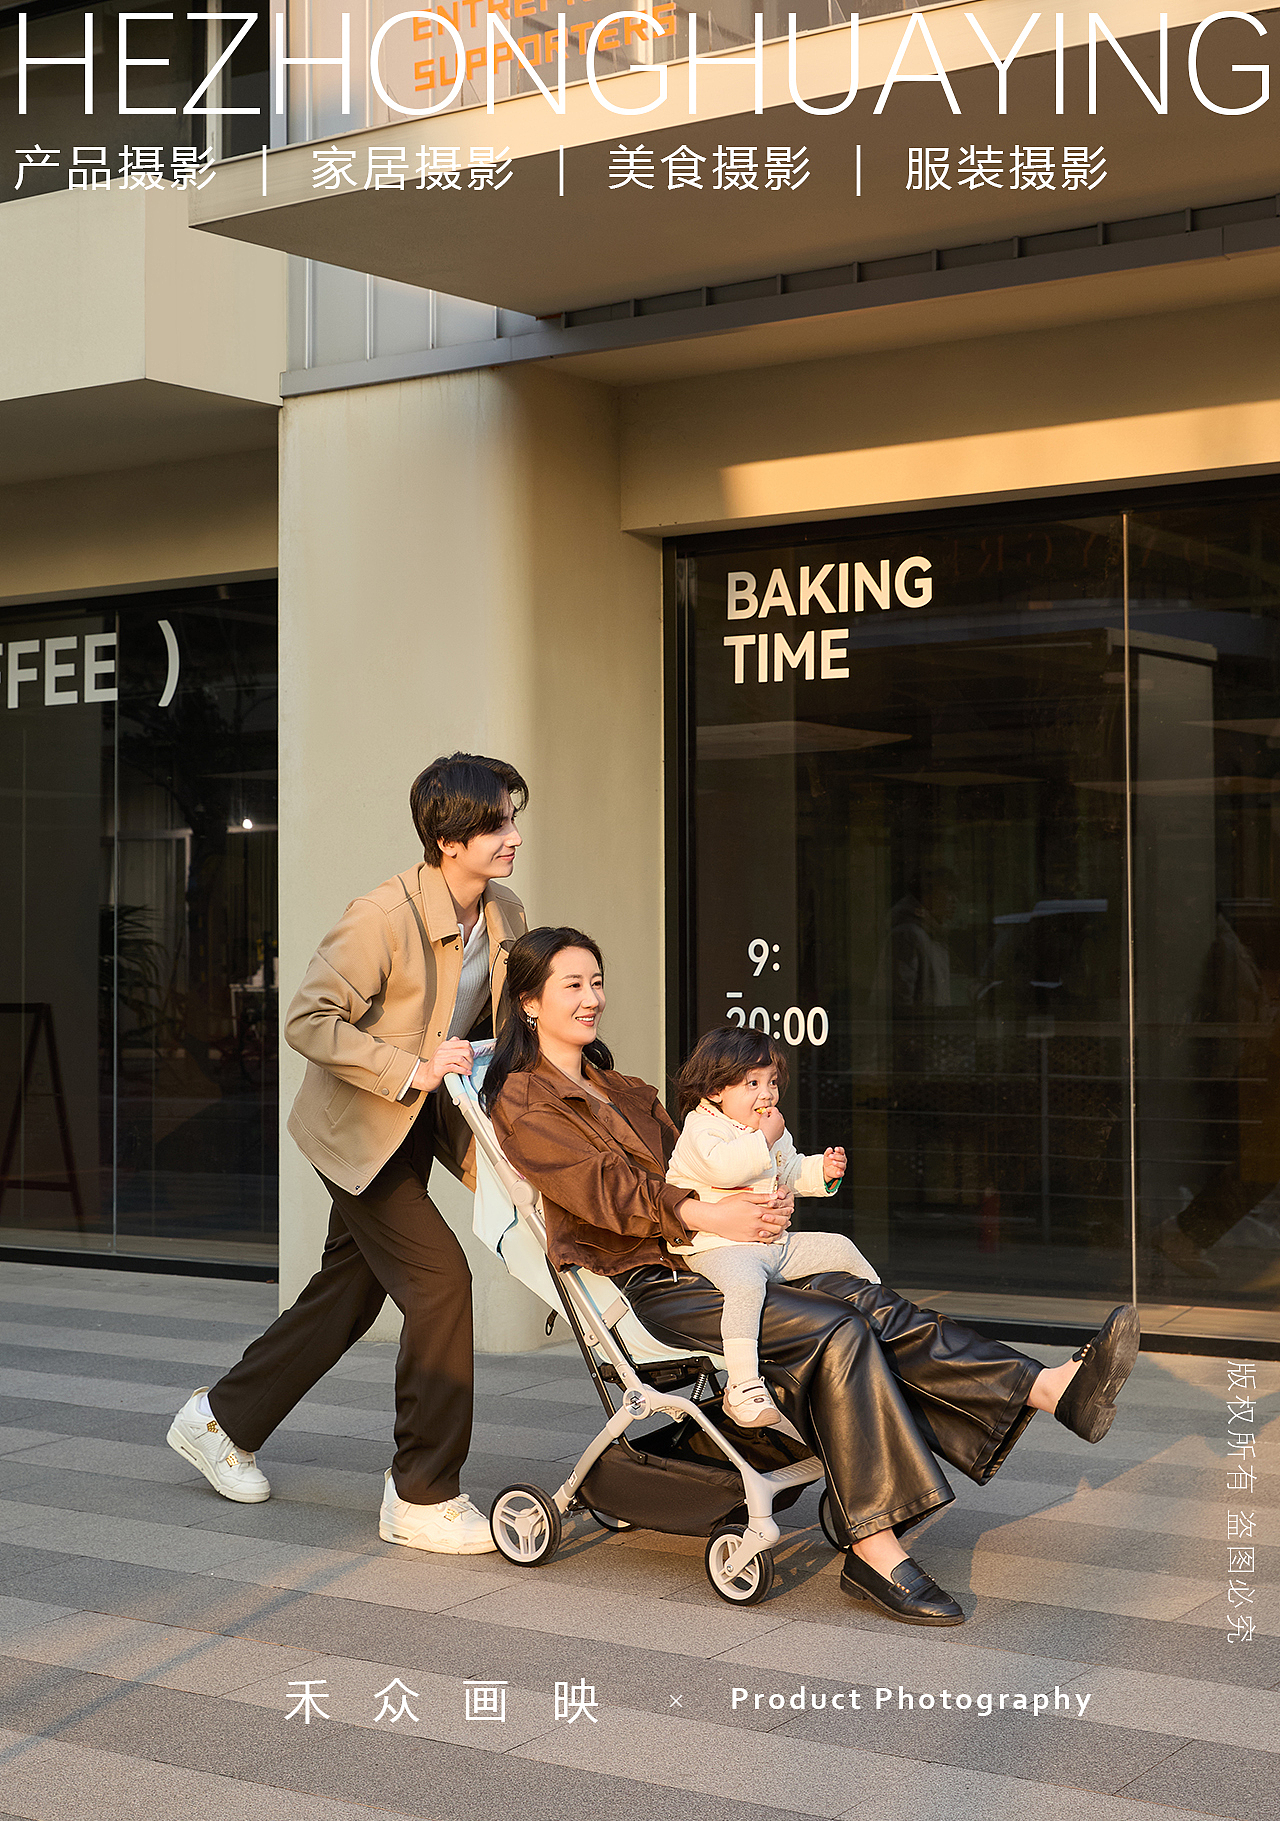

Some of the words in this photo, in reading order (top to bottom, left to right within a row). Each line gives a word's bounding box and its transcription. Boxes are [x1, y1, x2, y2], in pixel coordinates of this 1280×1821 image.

[414, 2, 677, 92] SUPPORTERS
[726, 556, 933, 621] BAKING
[0, 632, 118, 709] FEE
[723, 628, 850, 685] TIME
